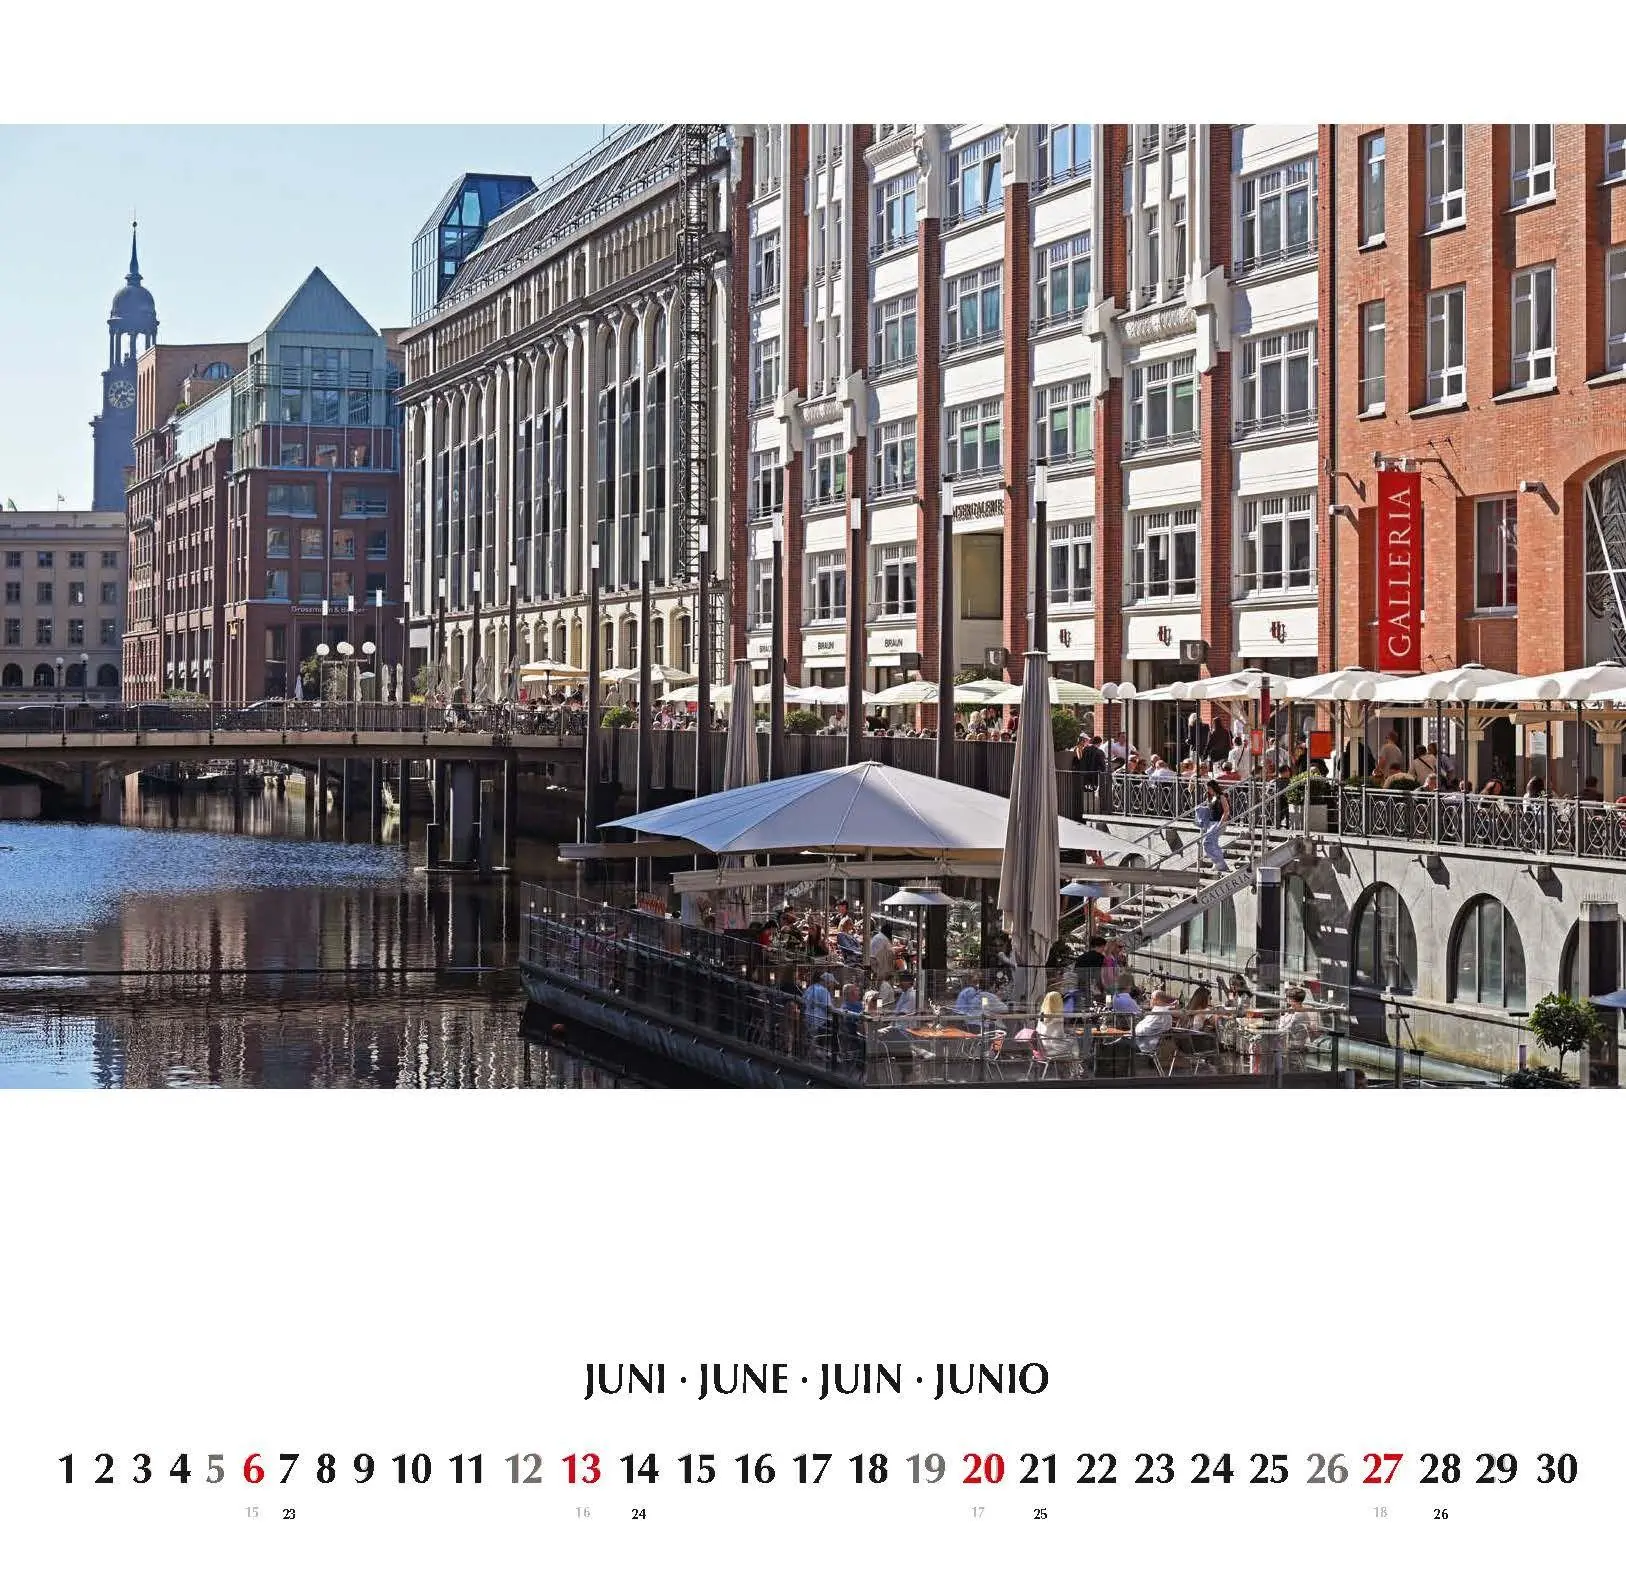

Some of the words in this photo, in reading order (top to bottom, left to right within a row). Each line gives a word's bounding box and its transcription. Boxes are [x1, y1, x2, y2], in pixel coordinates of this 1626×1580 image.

[1388, 488, 1411, 657] GALLERIA
[817, 641, 834, 650] BRAUN
[885, 639, 903, 648] BRAUN
[1201, 873, 1250, 905] GALLERIA
